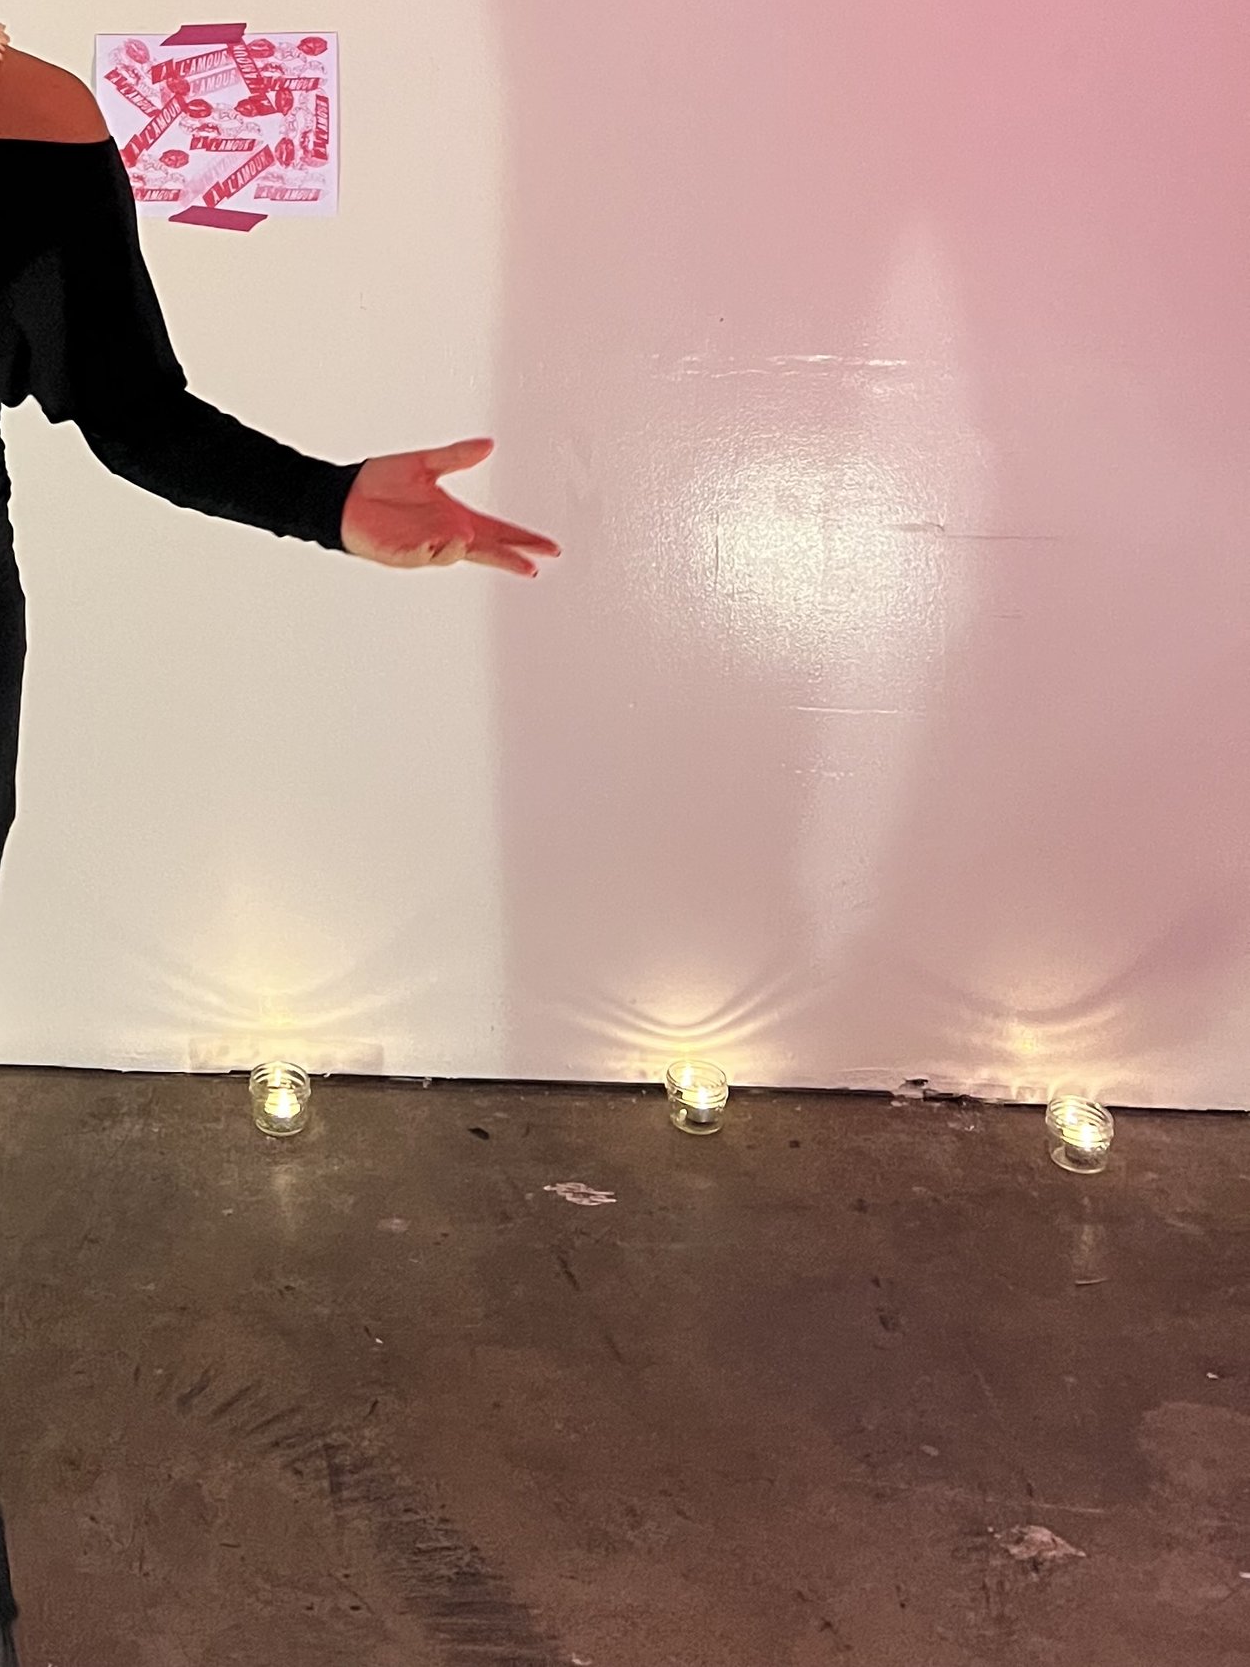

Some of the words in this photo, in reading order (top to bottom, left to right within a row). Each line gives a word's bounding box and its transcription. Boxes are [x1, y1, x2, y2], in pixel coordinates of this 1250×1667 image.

[180, 50, 230, 76] L'AMOUR
[145, 98, 181, 143] L'AMOUR
[228, 151, 269, 193] L'AMOUR
